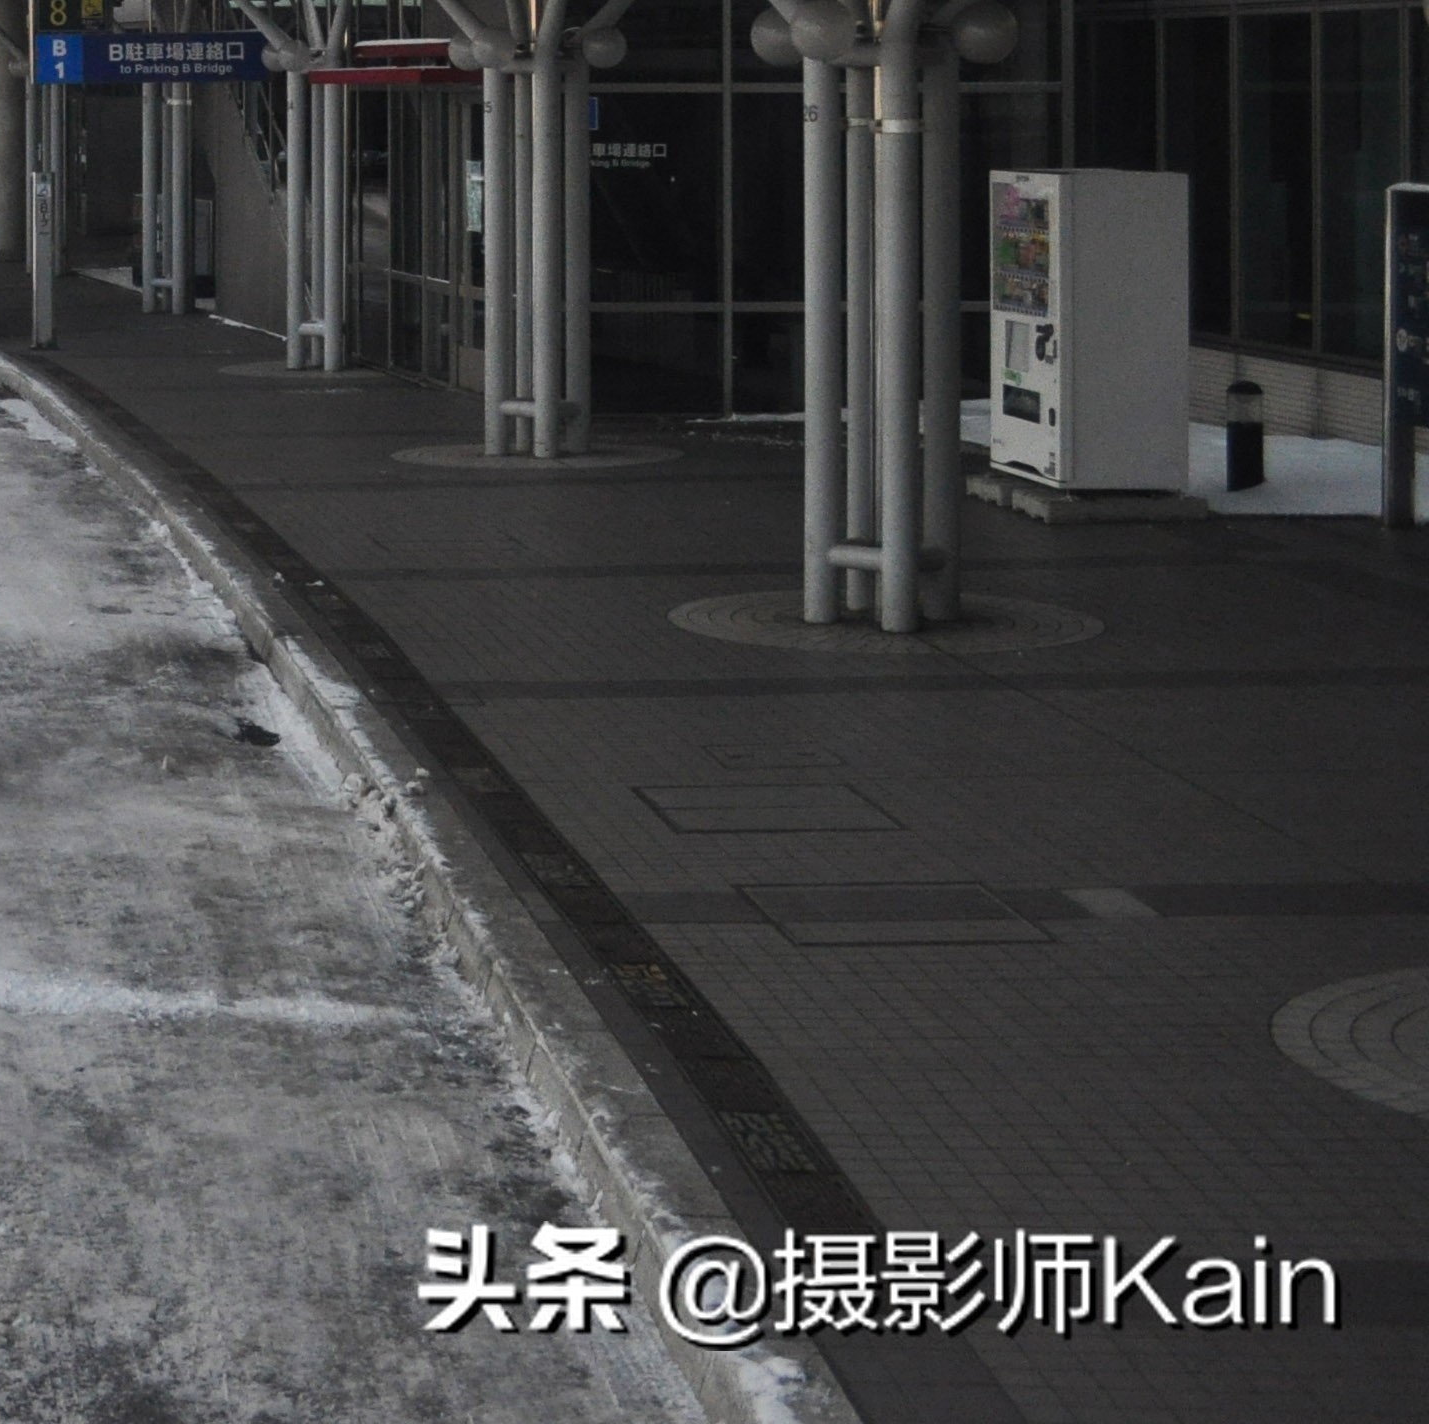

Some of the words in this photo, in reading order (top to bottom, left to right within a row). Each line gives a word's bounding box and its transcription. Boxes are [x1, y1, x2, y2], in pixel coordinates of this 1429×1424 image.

[52, 39, 67, 57] B
[108, 40, 245, 62] B駐車場連絡口
[55, 61, 65, 79] 1
[119, 65, 132, 74] to
[134, 64, 179, 76] Parking
[182, 64, 191, 74] B
[194, 64, 233, 76] Bridge
